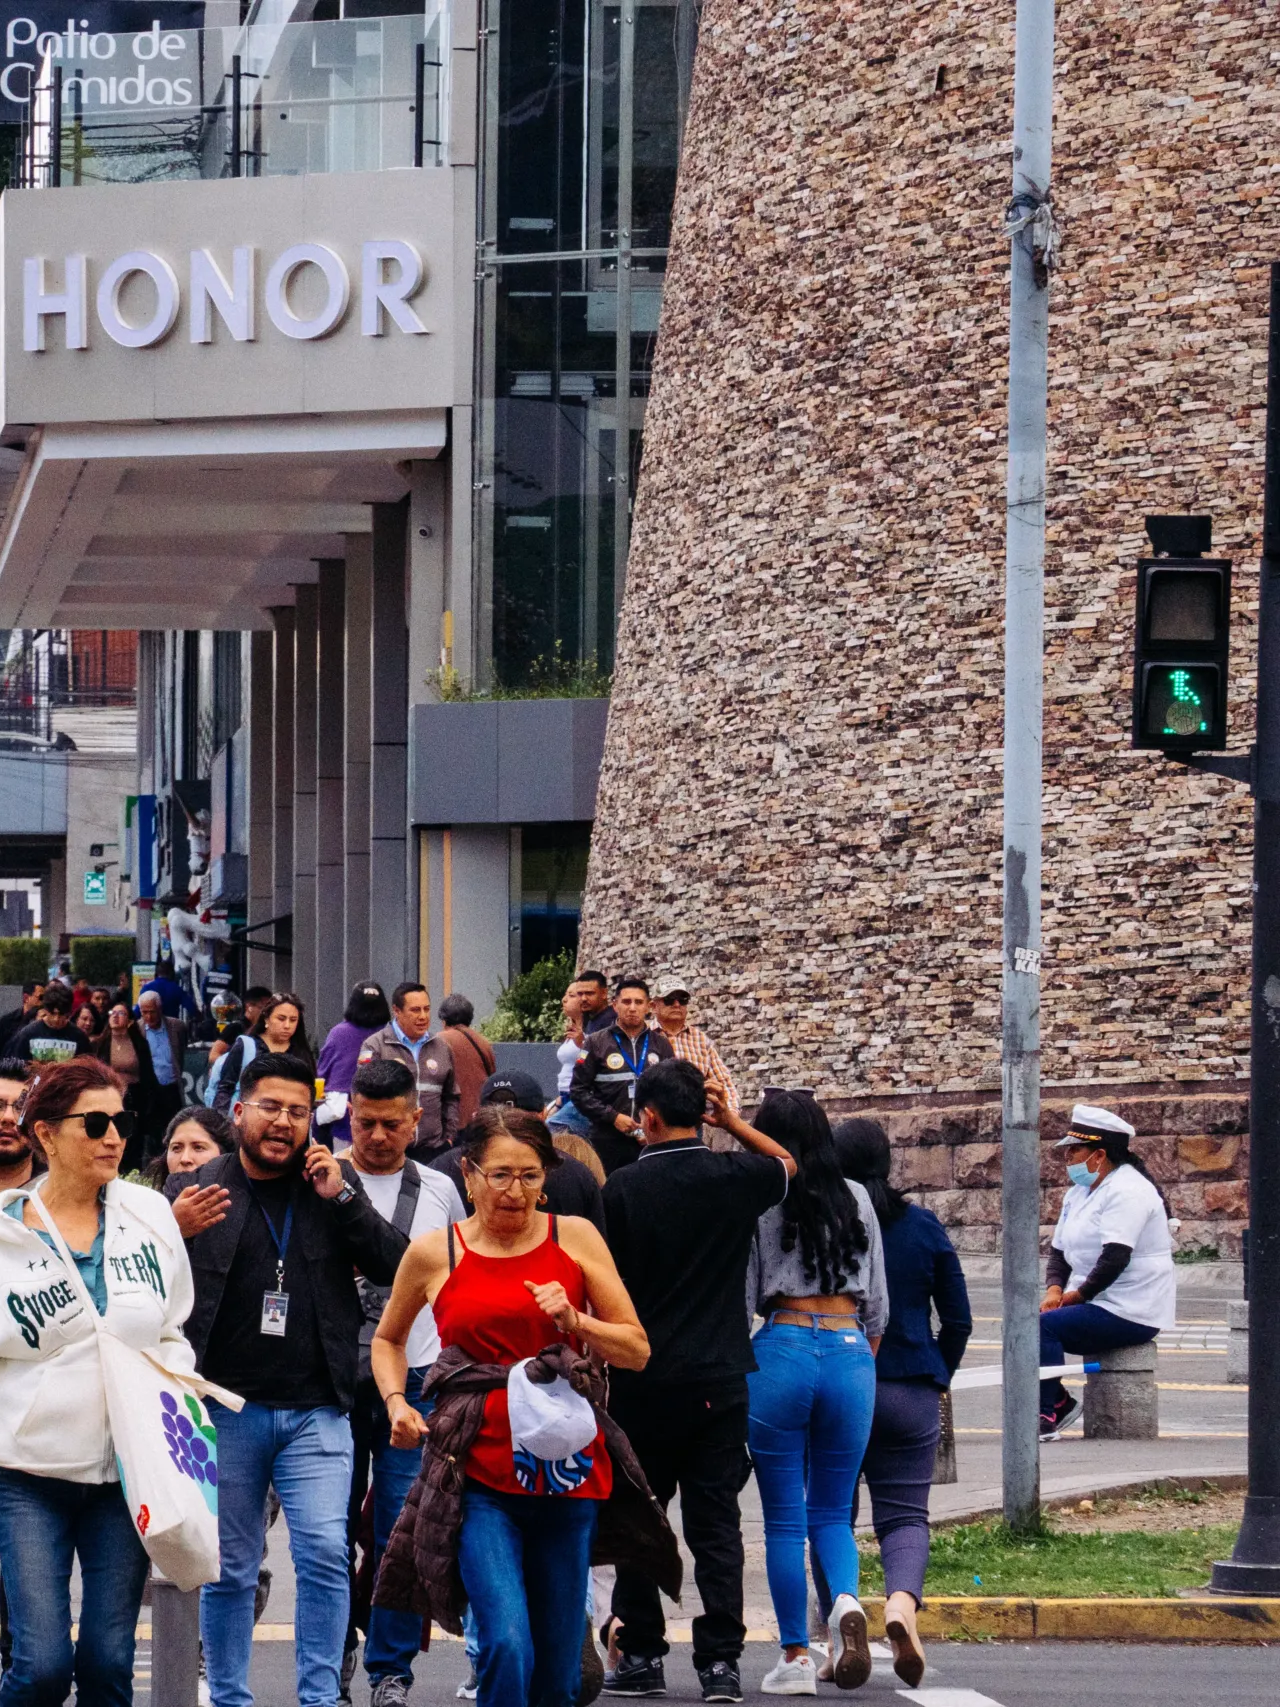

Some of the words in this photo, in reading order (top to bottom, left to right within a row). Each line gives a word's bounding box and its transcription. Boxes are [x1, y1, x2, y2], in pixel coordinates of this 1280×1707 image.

[7, 17, 117, 60] Patio
[132, 20, 187, 60] de
[0, 62, 193, 106] Cmidas
[23, 239, 430, 352] HONOR
[493, 1080, 512, 1088] USA
[108, 1239, 167, 1303] TERN
